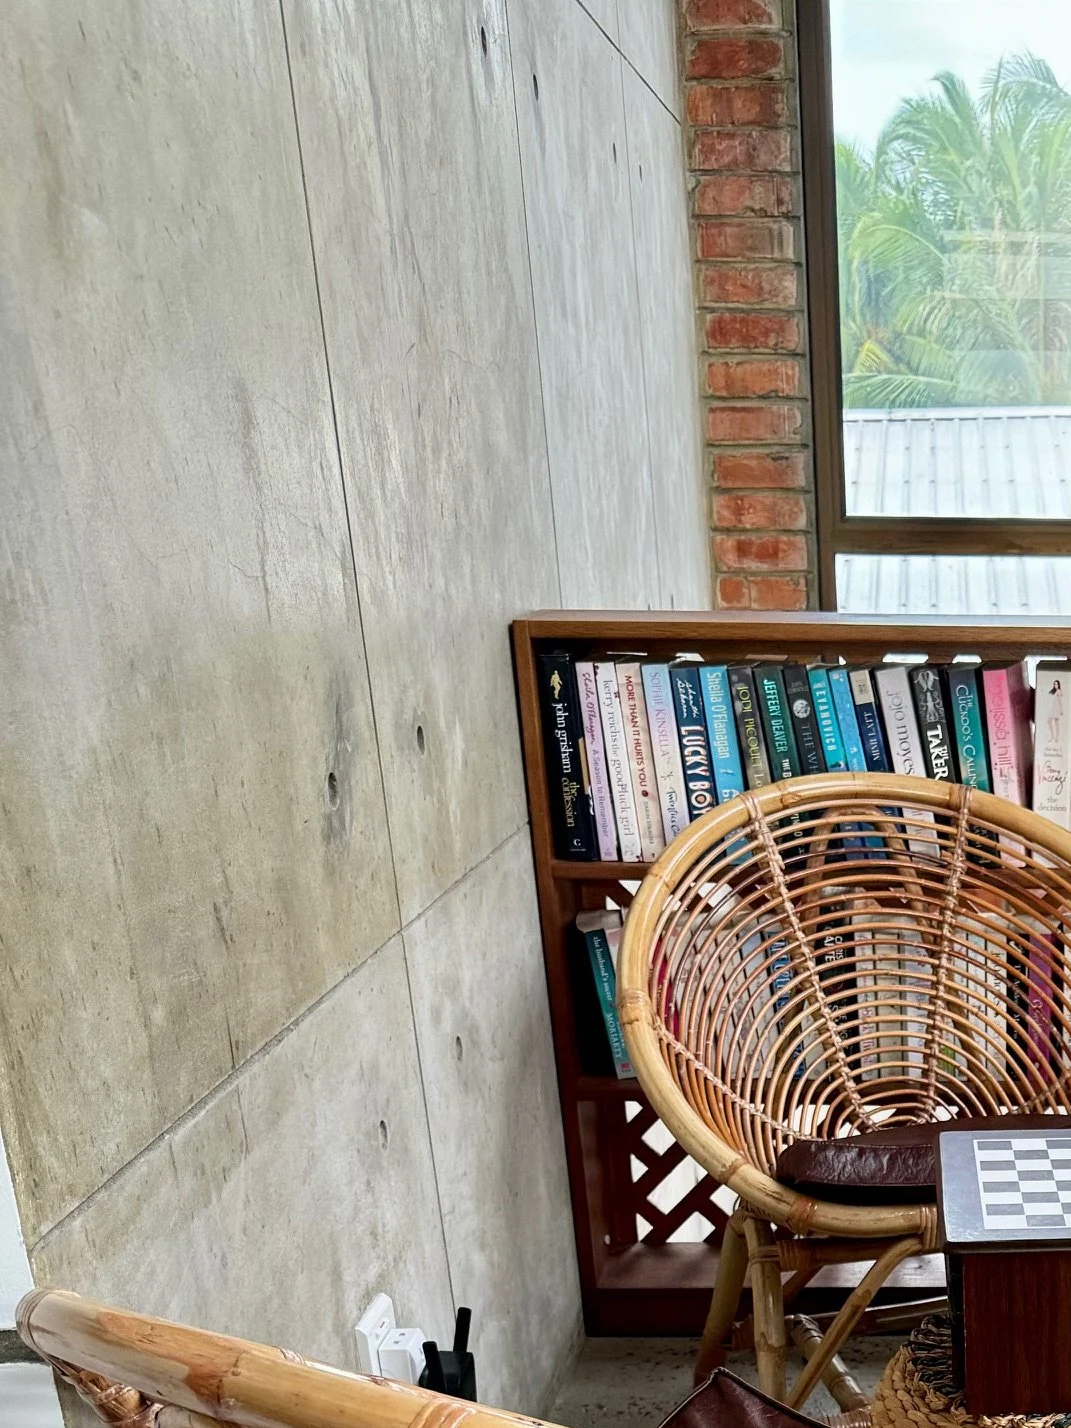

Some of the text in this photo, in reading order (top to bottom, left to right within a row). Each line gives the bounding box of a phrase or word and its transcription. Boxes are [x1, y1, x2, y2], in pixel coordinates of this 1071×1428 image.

[602, 680, 619, 743] kerry reichs
[650, 672, 670, 758] SOPHIE KINSELLA
[707, 672, 731, 759] Sheila O'Flanagan
[739, 684, 763, 769] JODI PICOULT
[763, 679, 781, 717] JEFFERY
[816, 691, 838, 751] EVANOVICH
[956, 684, 974, 742] CUCKOO'S
[555, 702, 573, 774] john grisham
[625, 675, 648, 788] MORE THAN IT HURTS YOU
[771, 719, 788, 753] DEAVER
[801, 722, 815, 747] THE
[885, 690, 916, 776] jojo moyes
[926, 724, 950, 781] TAKER
[681, 725, 713, 815] LUCKY BOY
[782, 758, 791, 771] THE
[561, 777, 579, 828] the confession
[593, 756, 602, 785] Season
[598, 796, 609, 838] Remember
[619, 816, 634, 837] girl
[592, 935, 601, 949] the
[595, 949, 609, 981] husband's
[606, 1013, 623, 1060] MORIARTY
